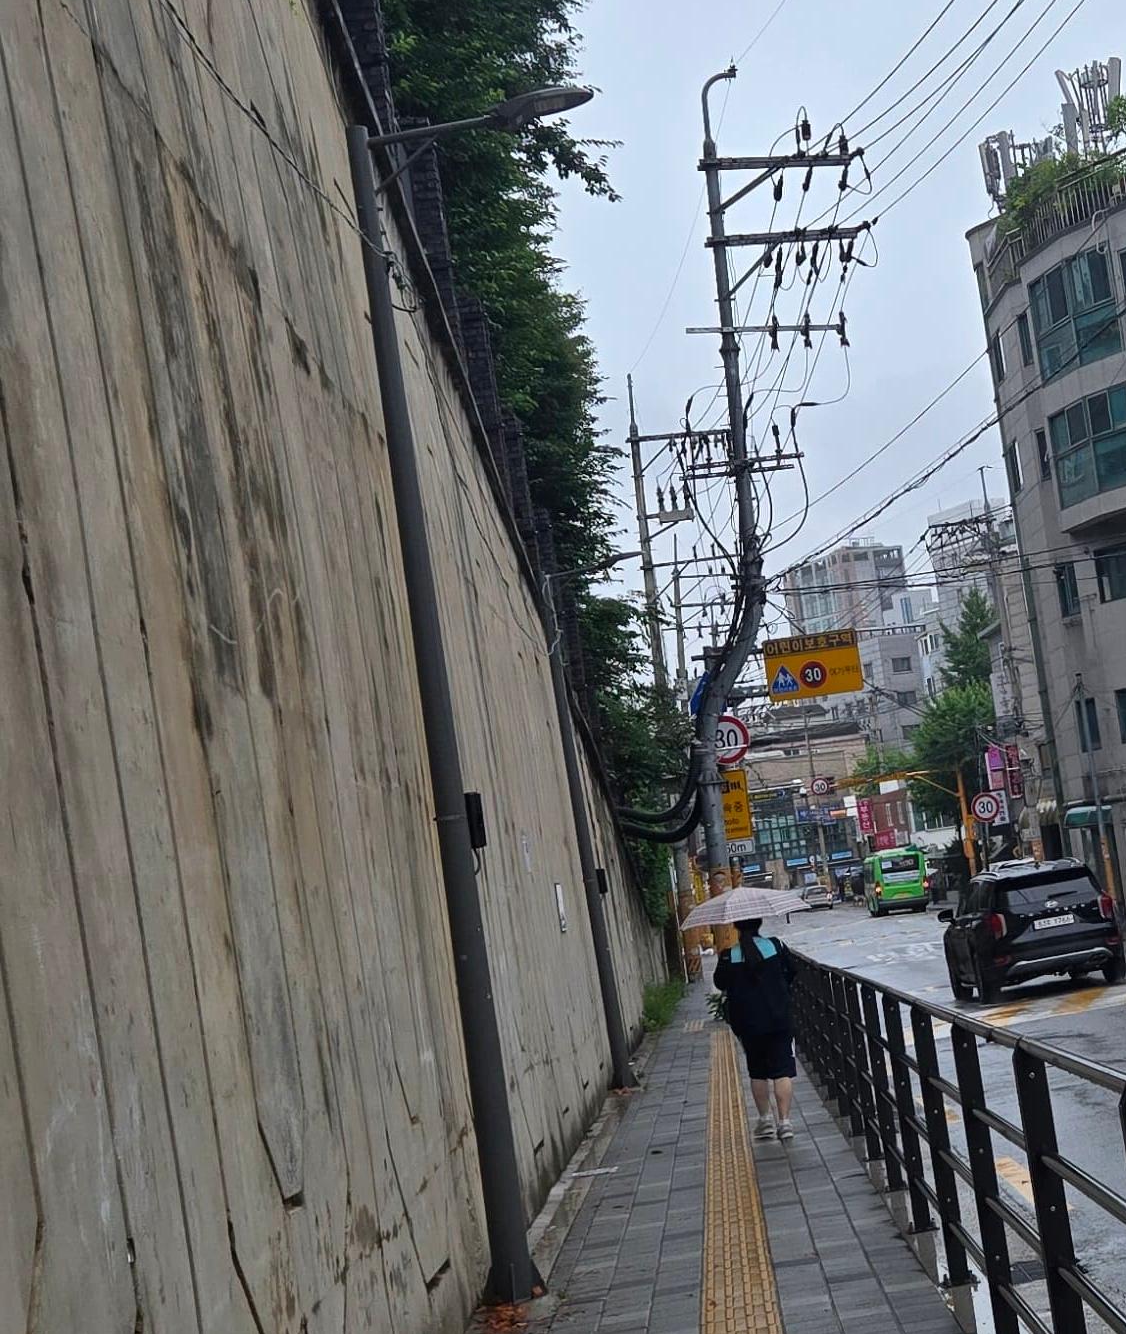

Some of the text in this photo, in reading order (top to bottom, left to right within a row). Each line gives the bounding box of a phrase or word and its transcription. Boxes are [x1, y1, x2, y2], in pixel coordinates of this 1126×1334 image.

[766, 632, 853, 656] 어린이보호구역
[804, 667, 822, 683] 30
[714, 729, 738, 748] 30
[814, 781, 826, 792] 30
[978, 800, 994, 814] 30
